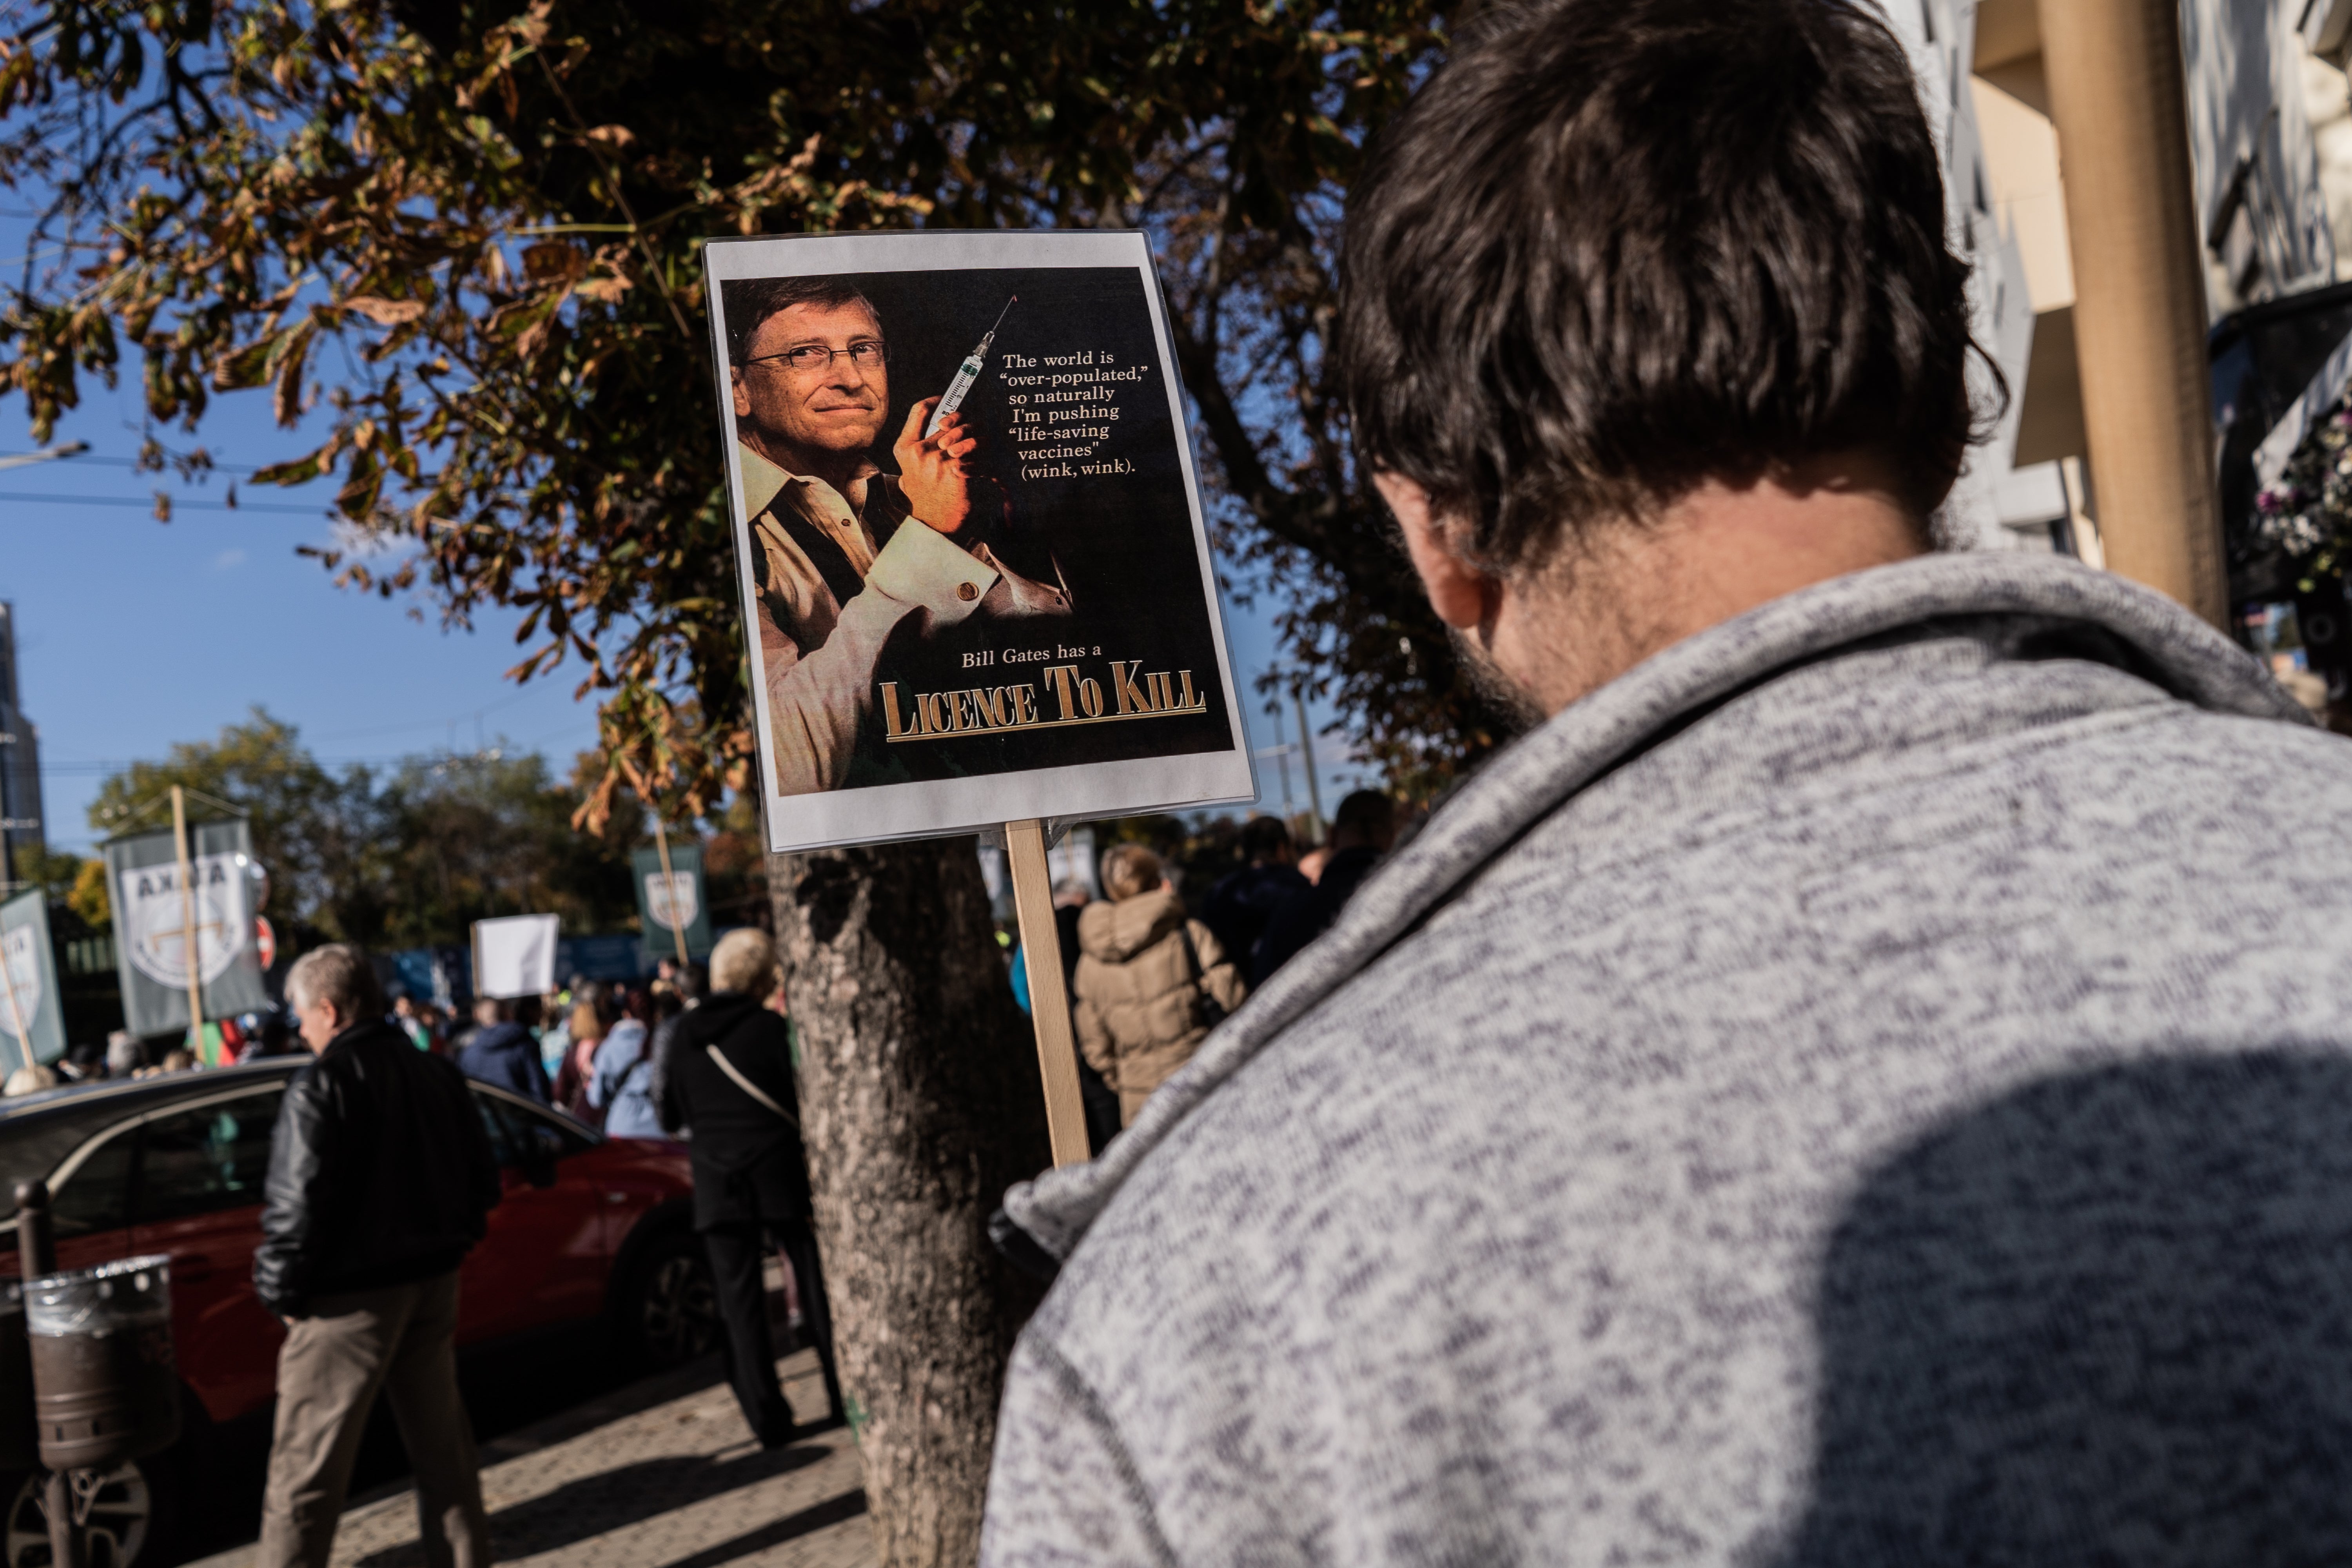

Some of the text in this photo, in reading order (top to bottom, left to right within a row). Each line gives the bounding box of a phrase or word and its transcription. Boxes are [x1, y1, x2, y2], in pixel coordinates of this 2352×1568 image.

[1002, 350, 1114, 368] The world is
[999, 365, 1148, 387] “over-populated,”
[1009, 386, 1115, 405] so naturally
[1012, 405, 1120, 424] I'm pushing
[1008, 423, 1110, 441] “life-saving
[1018, 441, 1099, 460] vaccines"
[1021, 458, 1136, 482] (wink, wink).
[962, 644, 1102, 668] Bill Gates has a
